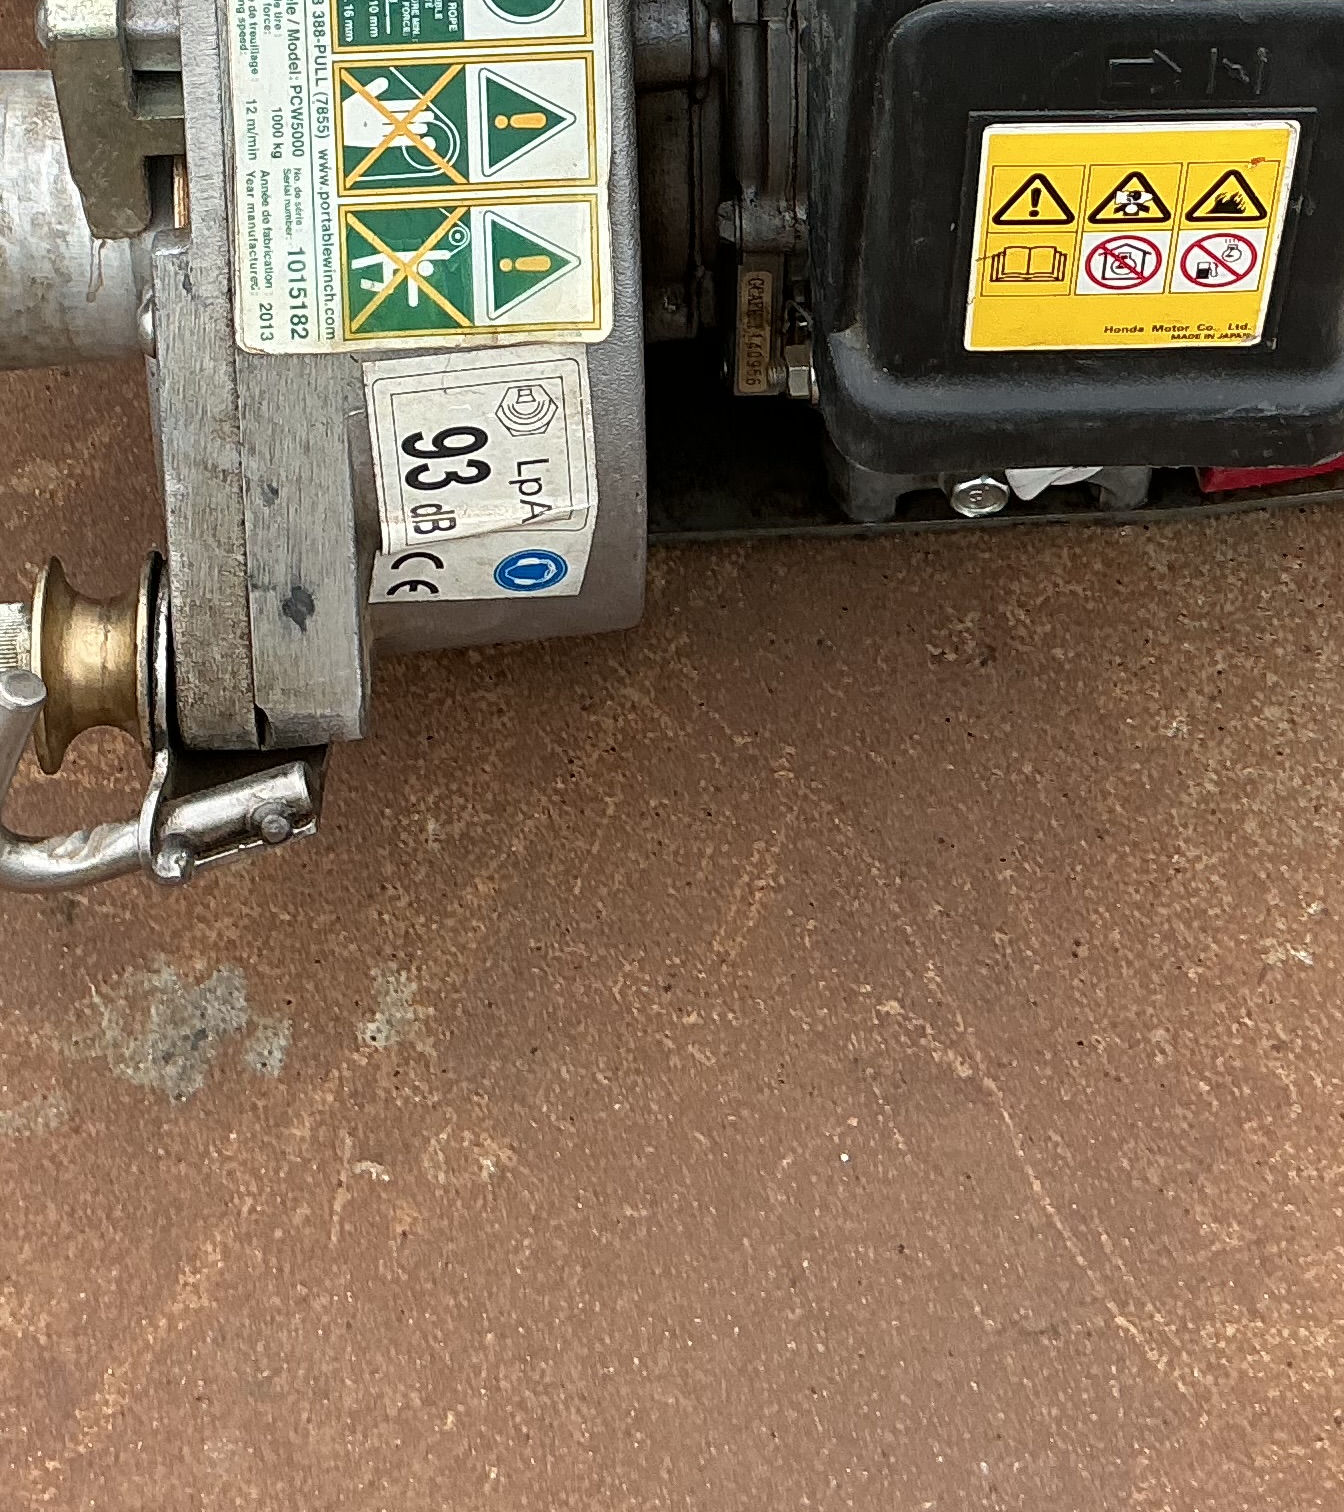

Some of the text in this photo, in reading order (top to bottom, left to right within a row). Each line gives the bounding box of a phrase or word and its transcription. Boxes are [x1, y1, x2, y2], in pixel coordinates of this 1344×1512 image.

[344, 19, 354, 43] mm
[368, 0, 380, 14] 10
[369, 15, 379, 38] mm
[448, 1, 458, 32] ROPE
[286, 27, 302, 82] Model:
[311, 10, 328, 87] 388-PULL
[245, 98, 260, 161] 12 m/min
[271, 106, 285, 159] 1000 kg
[289, 84, 305, 158] PCW5000
[312, 92, 330, 139] (7855)
[245, 170, 256, 199] Year
[317, 148, 337, 341] www.portablewinch.com
[287, 246, 310, 341] 1015182
[259, 302, 275, 342] 2013
[1103, 325, 1145, 334] Honda
[1151, 324, 1191, 333] Motor
[1170, 333, 1201, 341] MADE
[401, 425, 492, 535] 93 dB
[508, 457, 553, 525] LpA
